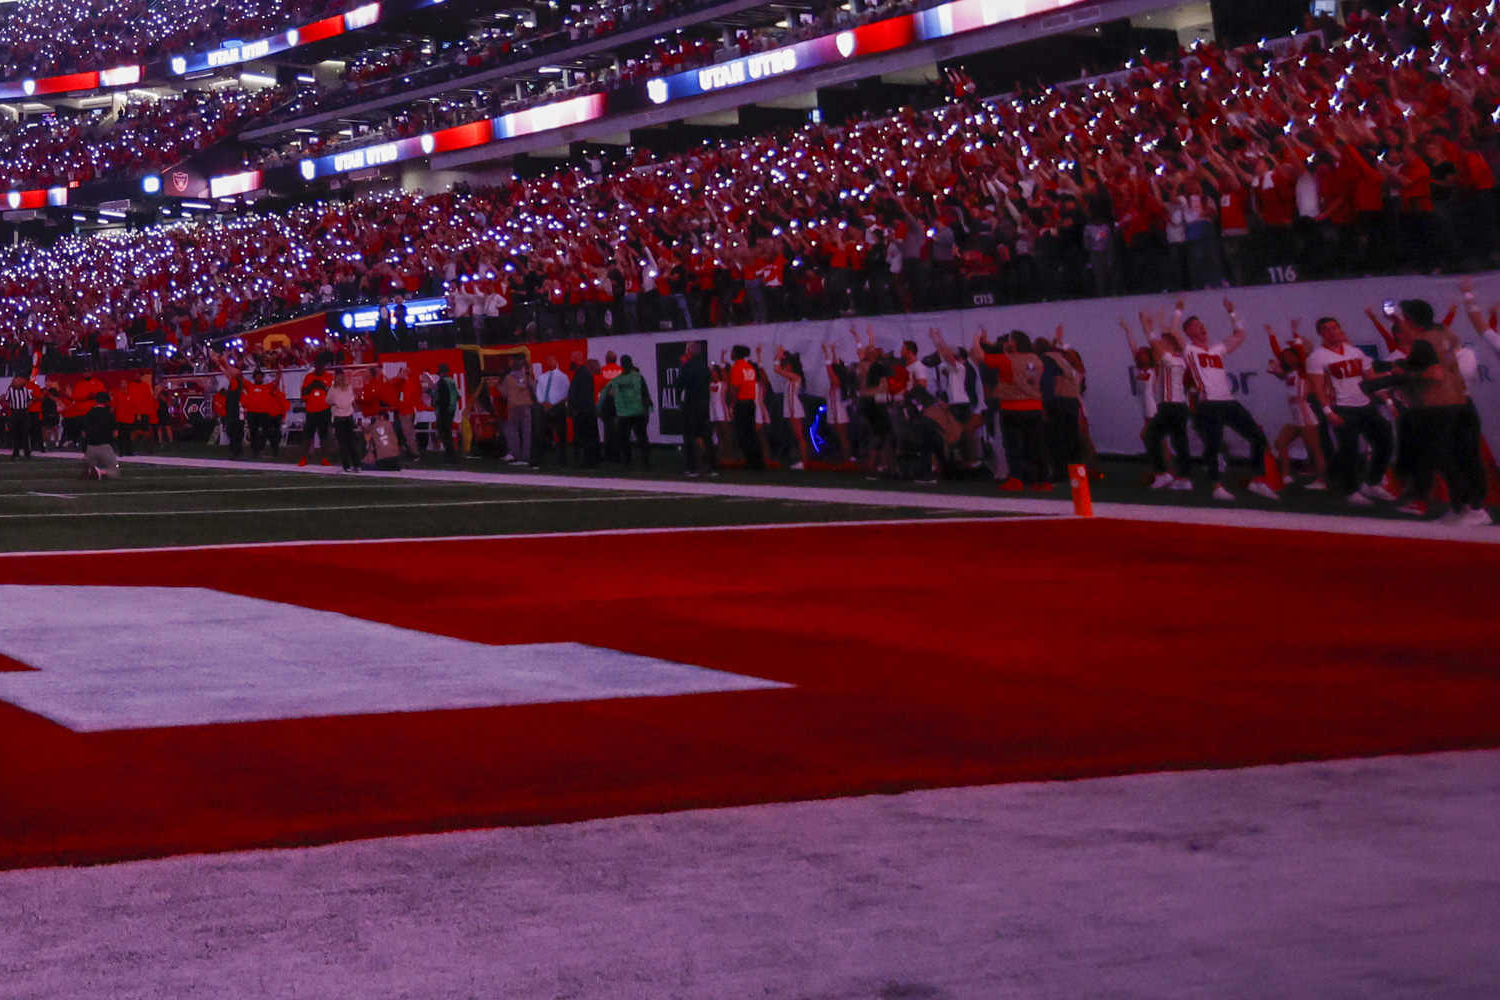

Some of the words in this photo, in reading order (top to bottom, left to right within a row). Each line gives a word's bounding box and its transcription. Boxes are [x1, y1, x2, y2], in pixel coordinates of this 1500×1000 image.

[699, 61, 745, 90] UTAH
[748, 48, 797, 79] UTES
[1268, 265, 1297, 283] 116
